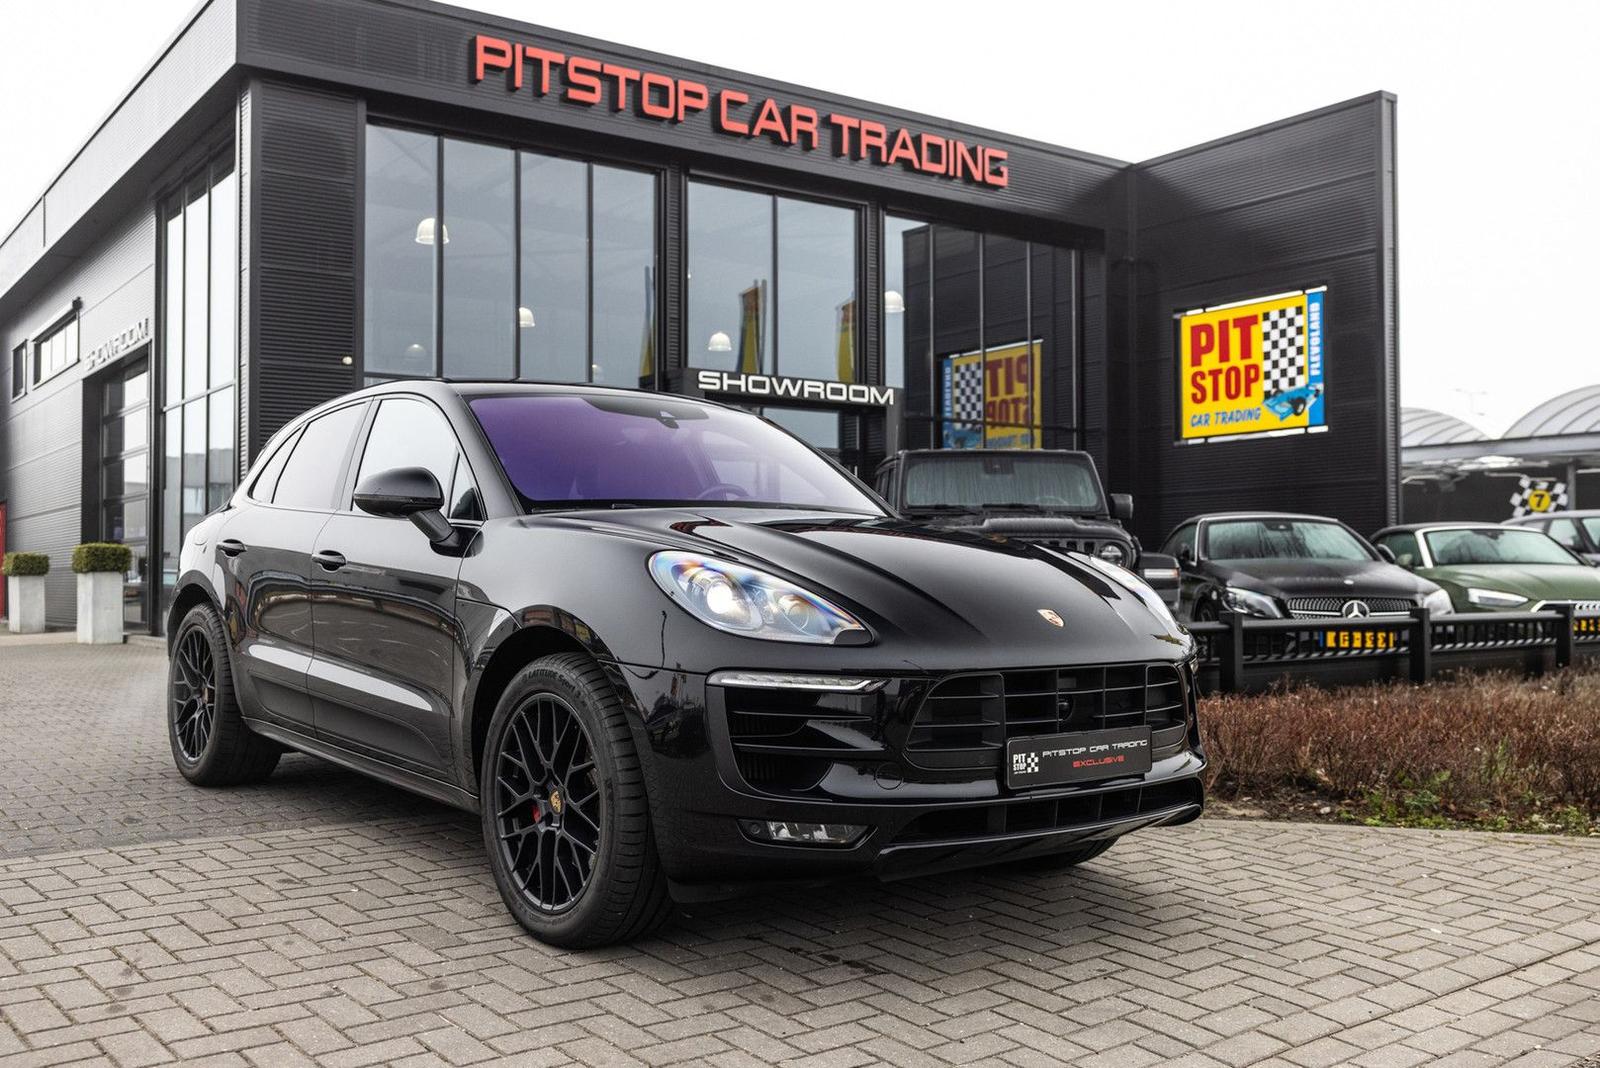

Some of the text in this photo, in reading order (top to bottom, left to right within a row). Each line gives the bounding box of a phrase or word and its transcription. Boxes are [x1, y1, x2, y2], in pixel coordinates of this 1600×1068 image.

[476, 35, 1008, 187] PITSTOP CAR TRADING
[1190, 314, 1259, 368] PIT
[1309, 302, 1321, 376] FLEVOLAND
[697, 370, 895, 406] SHOWROOM
[1191, 363, 1260, 405] STOP
[1190, 407, 1261, 428] CAR TRADING
[1534, 494, 1545, 508] 7
[1012, 753, 1026, 764] PIT
[1042, 739, 1148, 758] PITSTOP CAR TRADING
[1012, 763, 1027, 772] STOP
[1072, 755, 1126, 768] EXCLUSIVE
